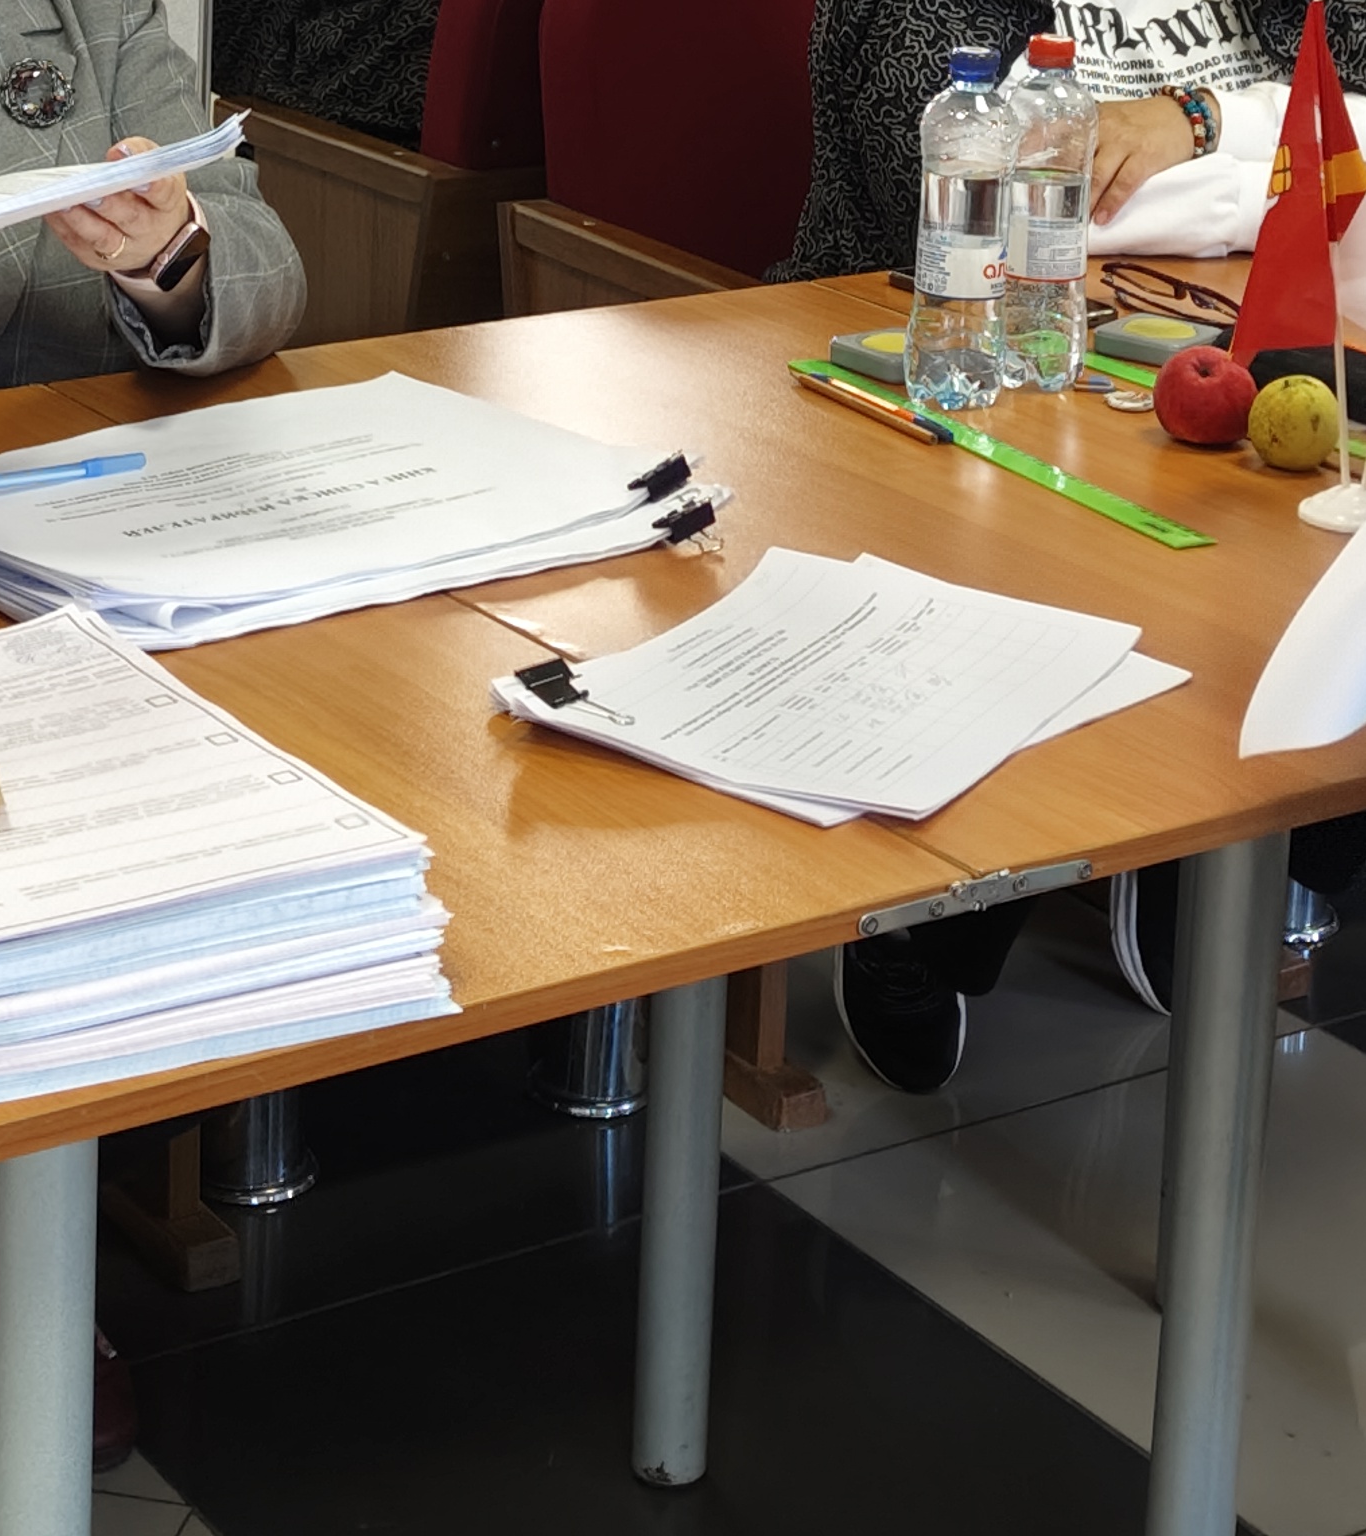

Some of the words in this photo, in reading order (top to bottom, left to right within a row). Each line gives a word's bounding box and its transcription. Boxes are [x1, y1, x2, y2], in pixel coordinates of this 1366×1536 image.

[1107, 59, 1155, 71] THORNS
[1186, 55, 1221, 76] ROAD
[1103, 84, 1162, 98] STRONG-W
[367, 465, 437, 487] КНИГА
